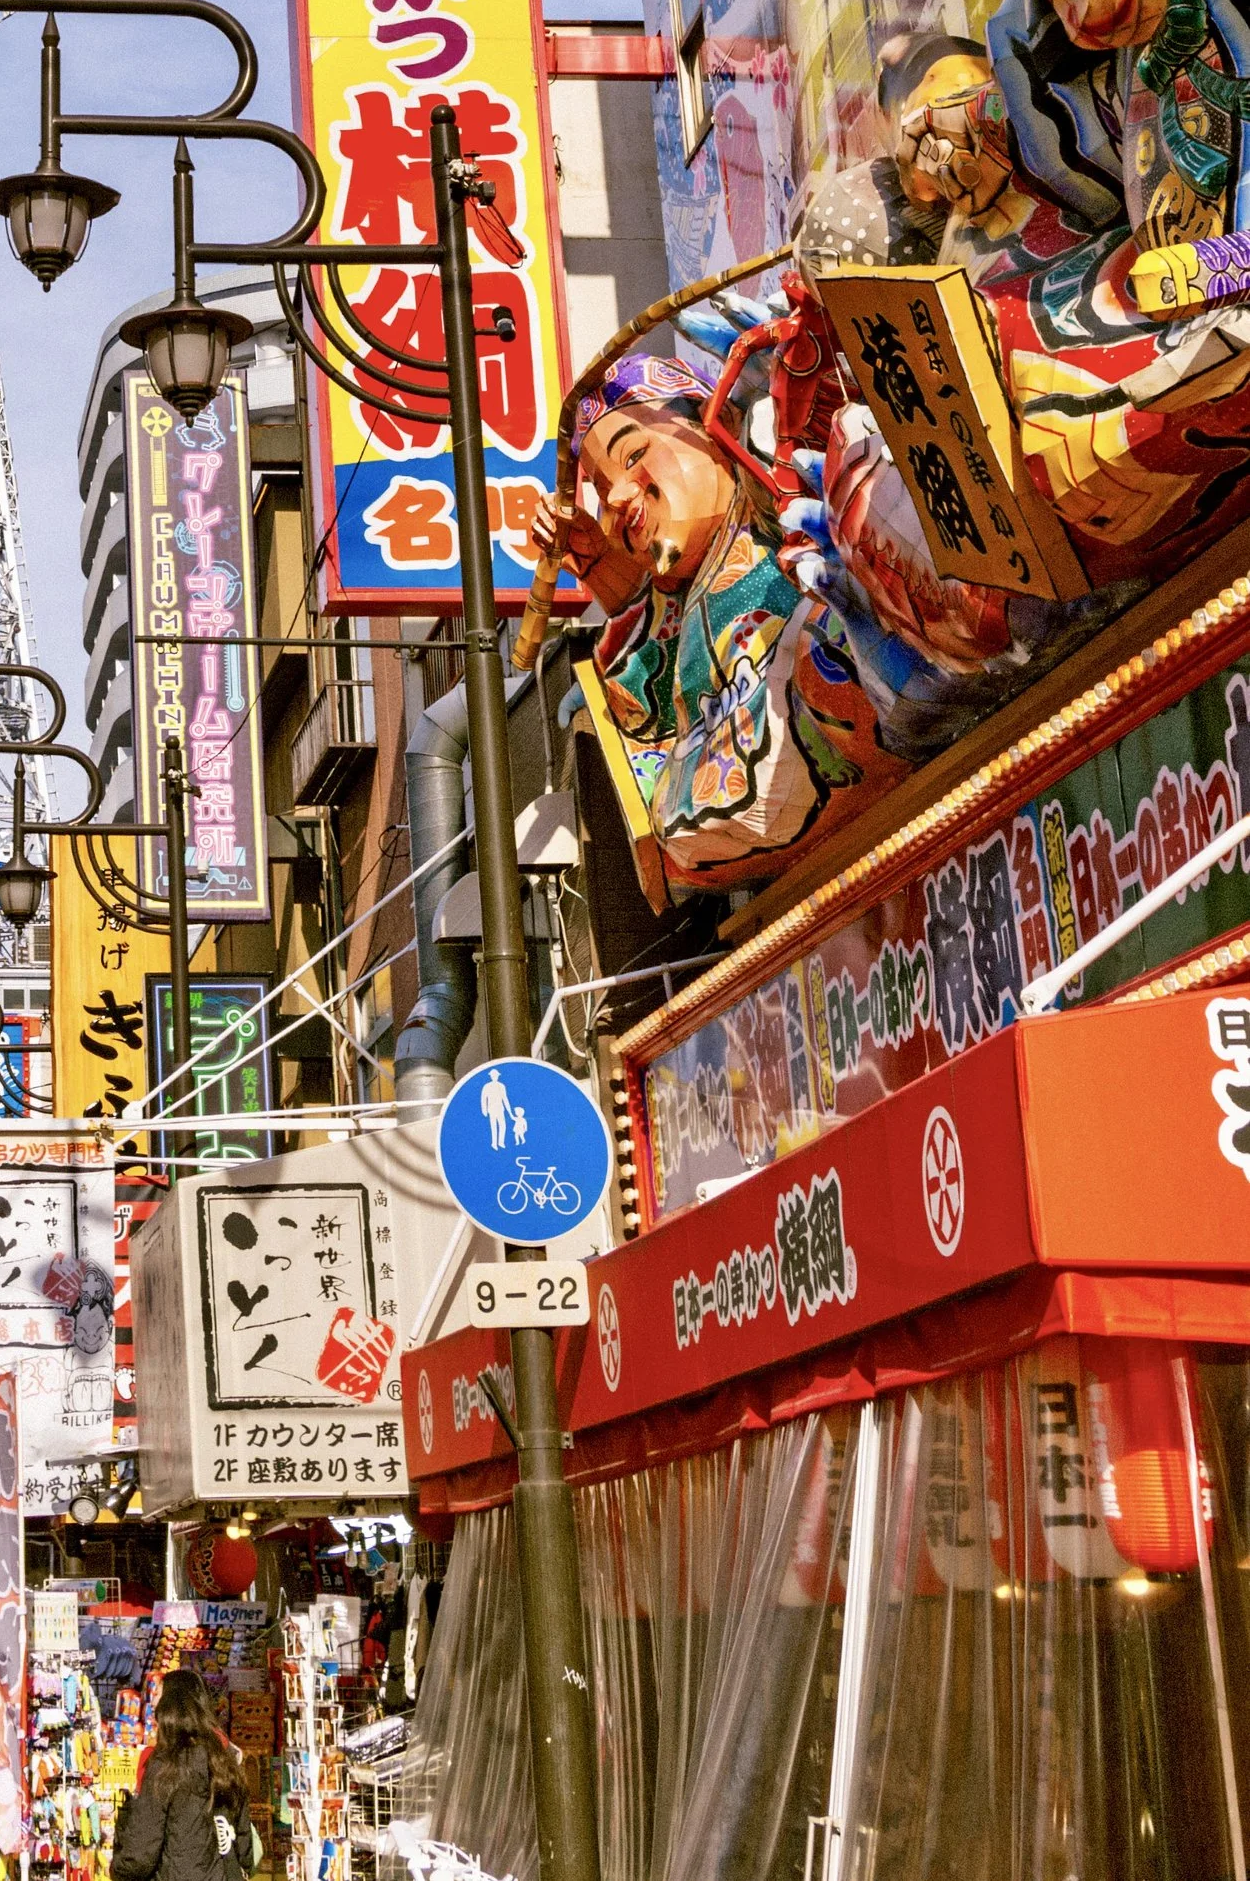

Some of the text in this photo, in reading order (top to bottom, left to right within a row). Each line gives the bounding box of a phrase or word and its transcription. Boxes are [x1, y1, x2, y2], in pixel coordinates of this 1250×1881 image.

[339, 88, 539, 453] 横綱
[1070, 771, 1234, 945] 日本一の串かつ
[827, 938, 930, 1073] 日本一の串かつ
[927, 832, 1022, 1051] 横綱
[221, 1211, 312, 1386] いっとく
[310, 1214, 352, 1303] 新世界
[372, 1188, 399, 1318] 商標登録
[213, 1422, 400, 1448] 1F カウンター席
[213, 1457, 402, 1484] 2F 座敷あります
